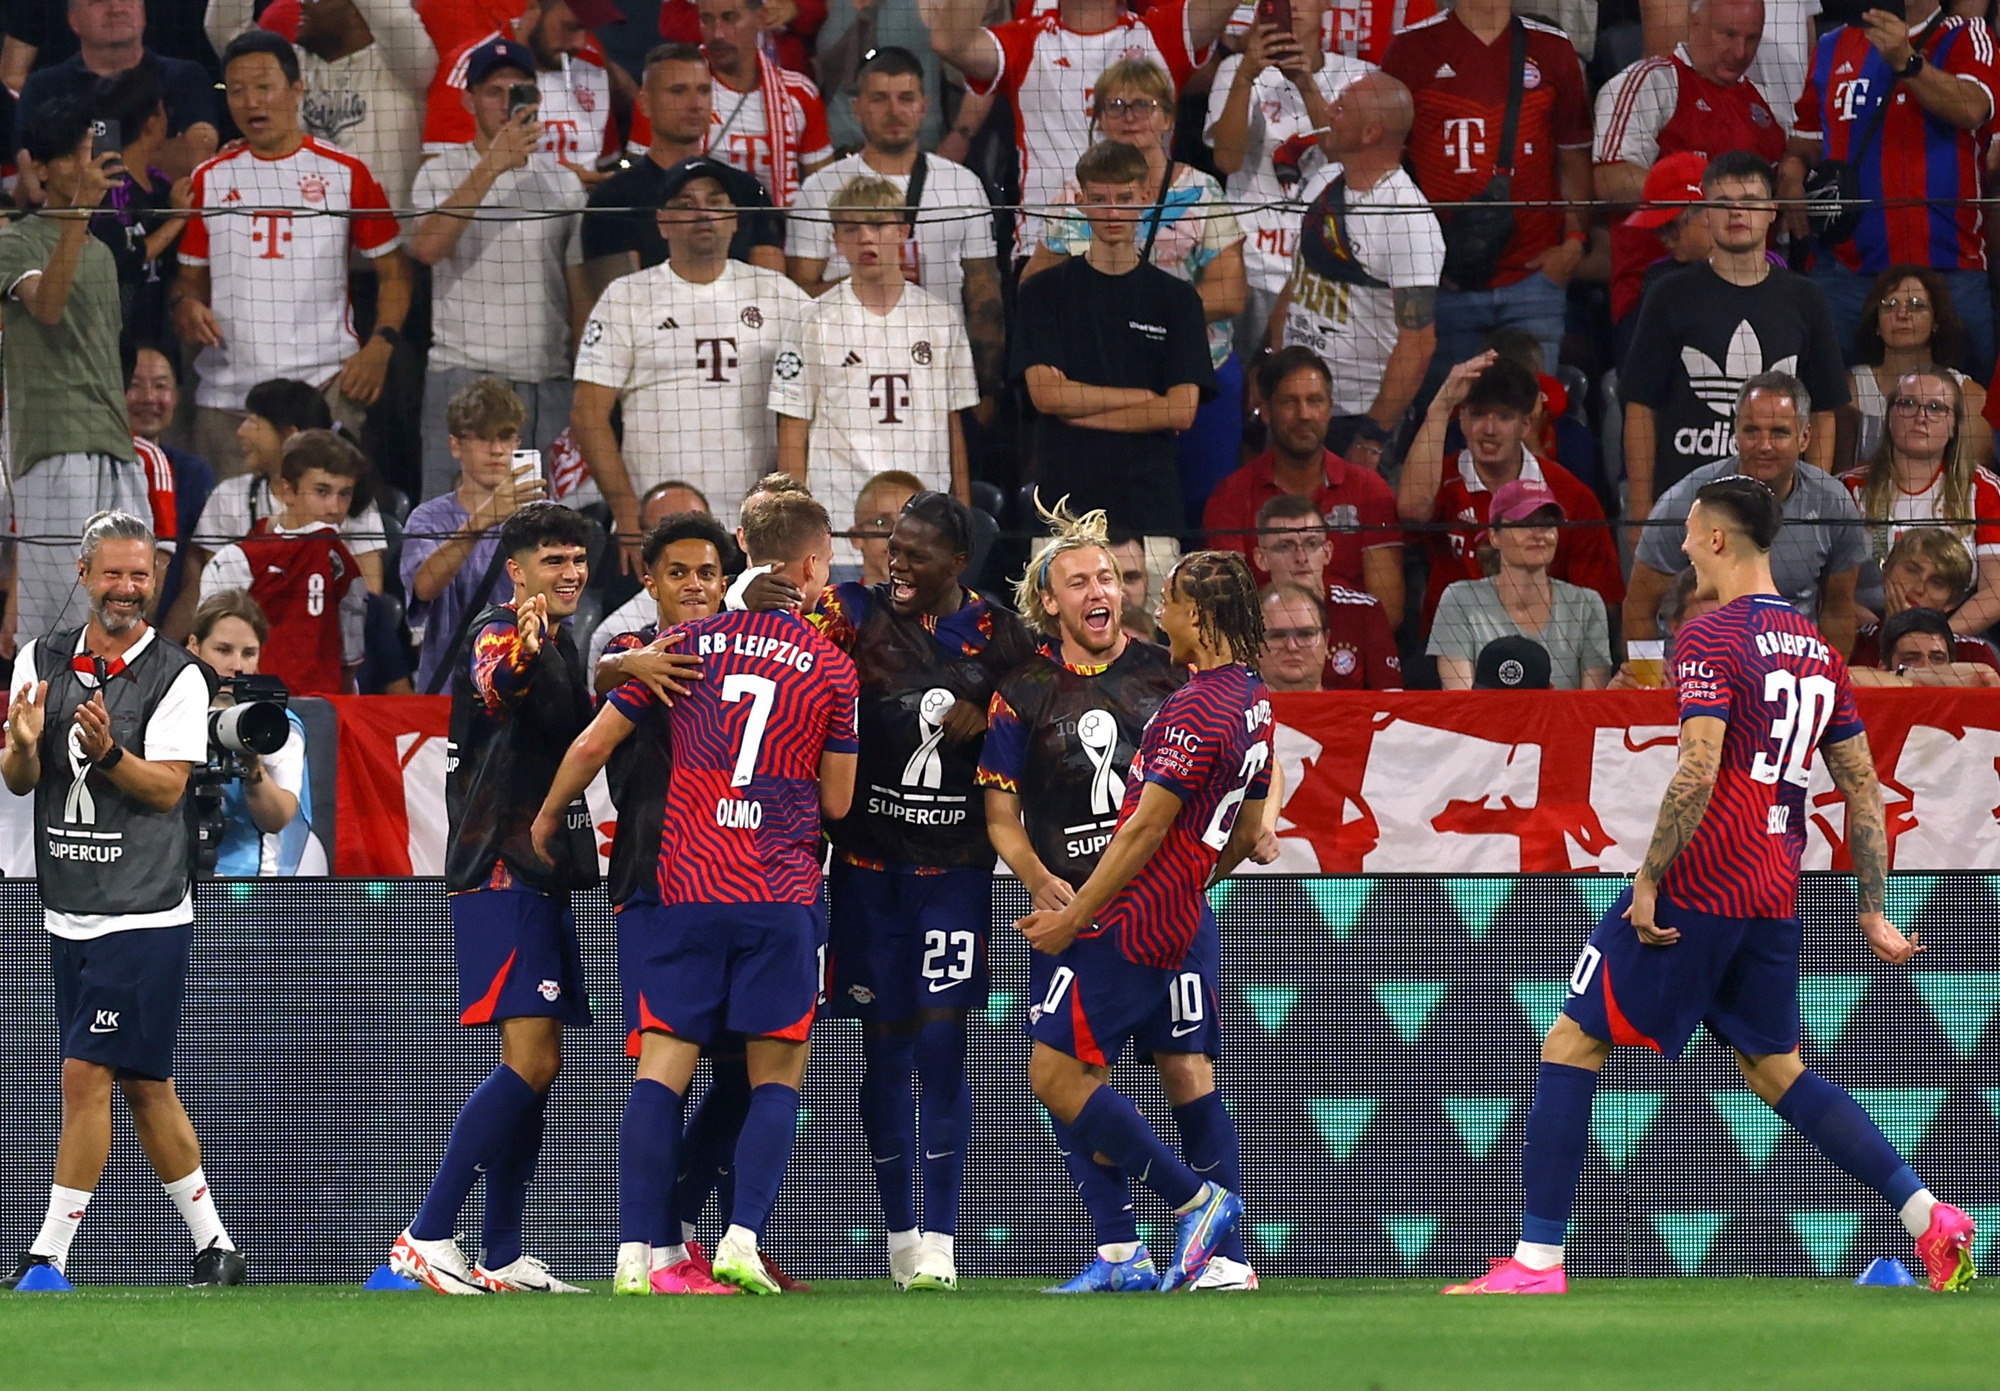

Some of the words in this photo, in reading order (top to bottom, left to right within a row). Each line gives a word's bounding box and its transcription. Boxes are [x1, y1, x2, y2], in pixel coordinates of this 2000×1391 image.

[1834, 78, 1871, 121] T
[1443, 118, 1486, 174] T
[252, 210, 293, 260] T
[696, 337, 738, 383] T
[868, 374, 910, 424] T
[308, 573, 325, 617] 8
[699, 632, 727, 656] RB
[733, 633, 814, 673] LEIPZIG
[1755, 631, 1780, 657] RB
[721, 674, 777, 788] 7
[1164, 726, 1201, 753] IHG
[1750, 668, 1837, 788] 30
[716, 798, 762, 830] OLMO
[868, 798, 966, 825] SUPERCUP
[49, 840, 123, 863] SUPERCUP
[922, 929, 975, 980] 23
[95, 1009, 120, 1028] KK
[1169, 972, 1203, 1022] 10
